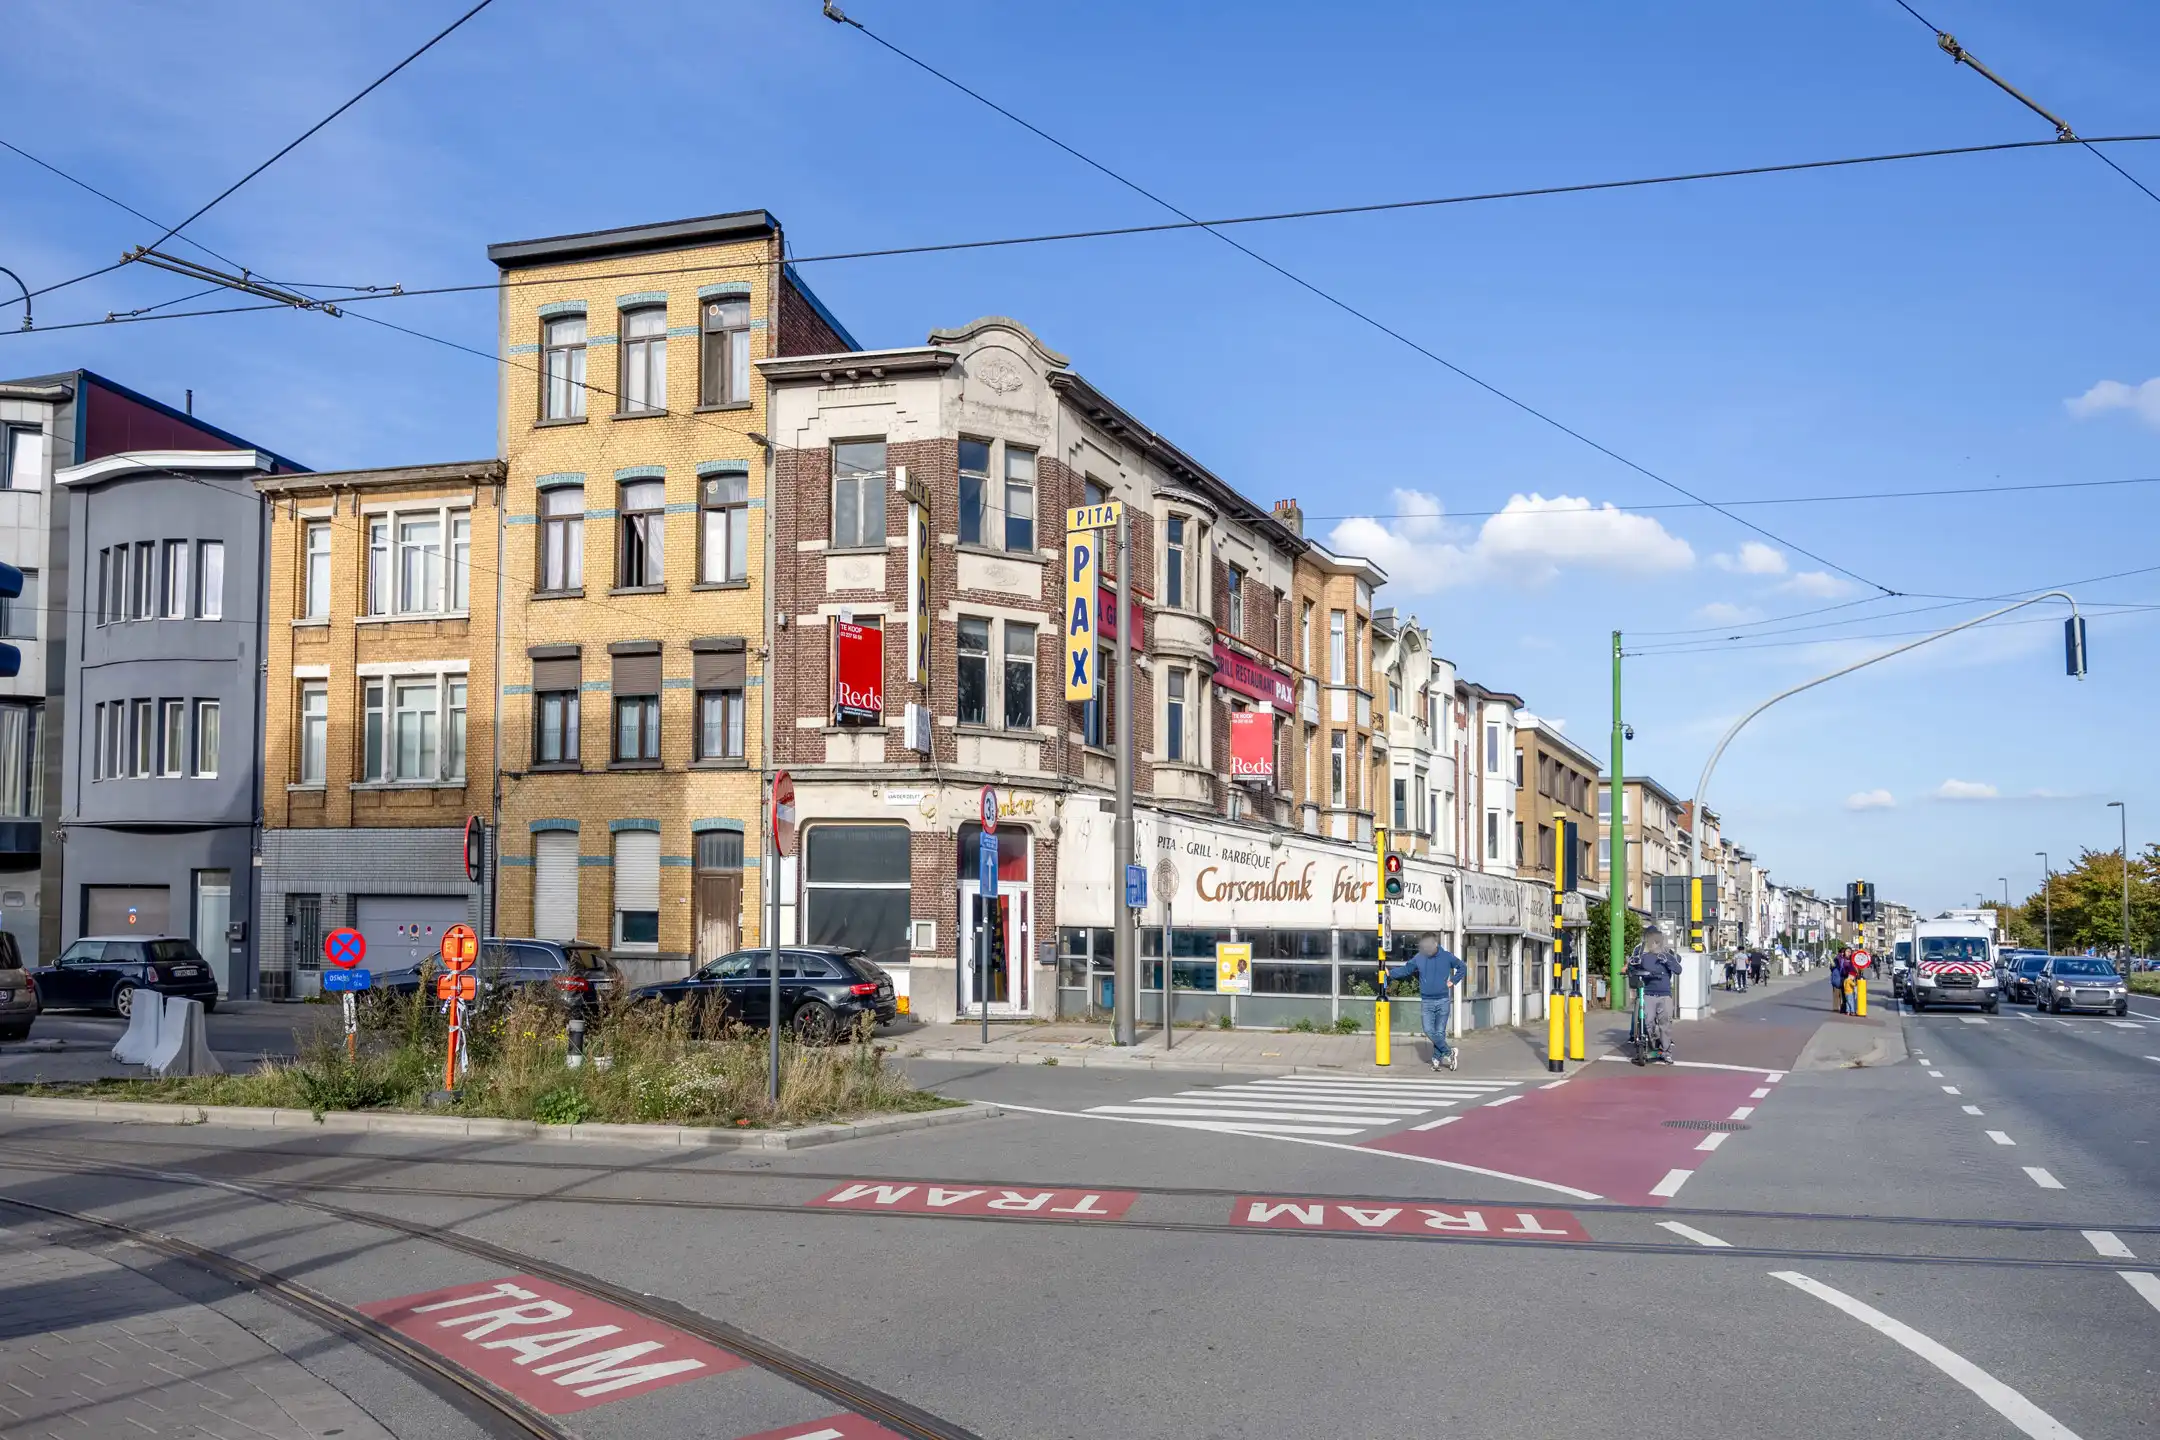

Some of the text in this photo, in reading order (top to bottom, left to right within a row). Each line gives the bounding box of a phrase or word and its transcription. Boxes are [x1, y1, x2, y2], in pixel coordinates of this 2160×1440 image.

[909, 473, 925, 502] PITA
[1077, 506, 1113, 526] PITA
[919, 520, 927, 671] PAX
[848, 625, 862, 633] KOOP
[1070, 545, 1090, 687] PAX
[839, 681, 882, 710] Reds
[1235, 663, 1275, 695] RESTAURANT
[1275, 681, 1293, 704] PAX
[1232, 757, 1273, 774] Reds
[1157, 836, 1271, 869] PITA GRILL BARBEQUE
[1196, 861, 1374, 903] Corsendonk bier
[1404, 881, 1422, 895] PITA
[827, 1184, 1108, 1215] TRAM
[1247, 1202, 1568, 1235] TRAM
[411, 1283, 707, 1397] TRAM
